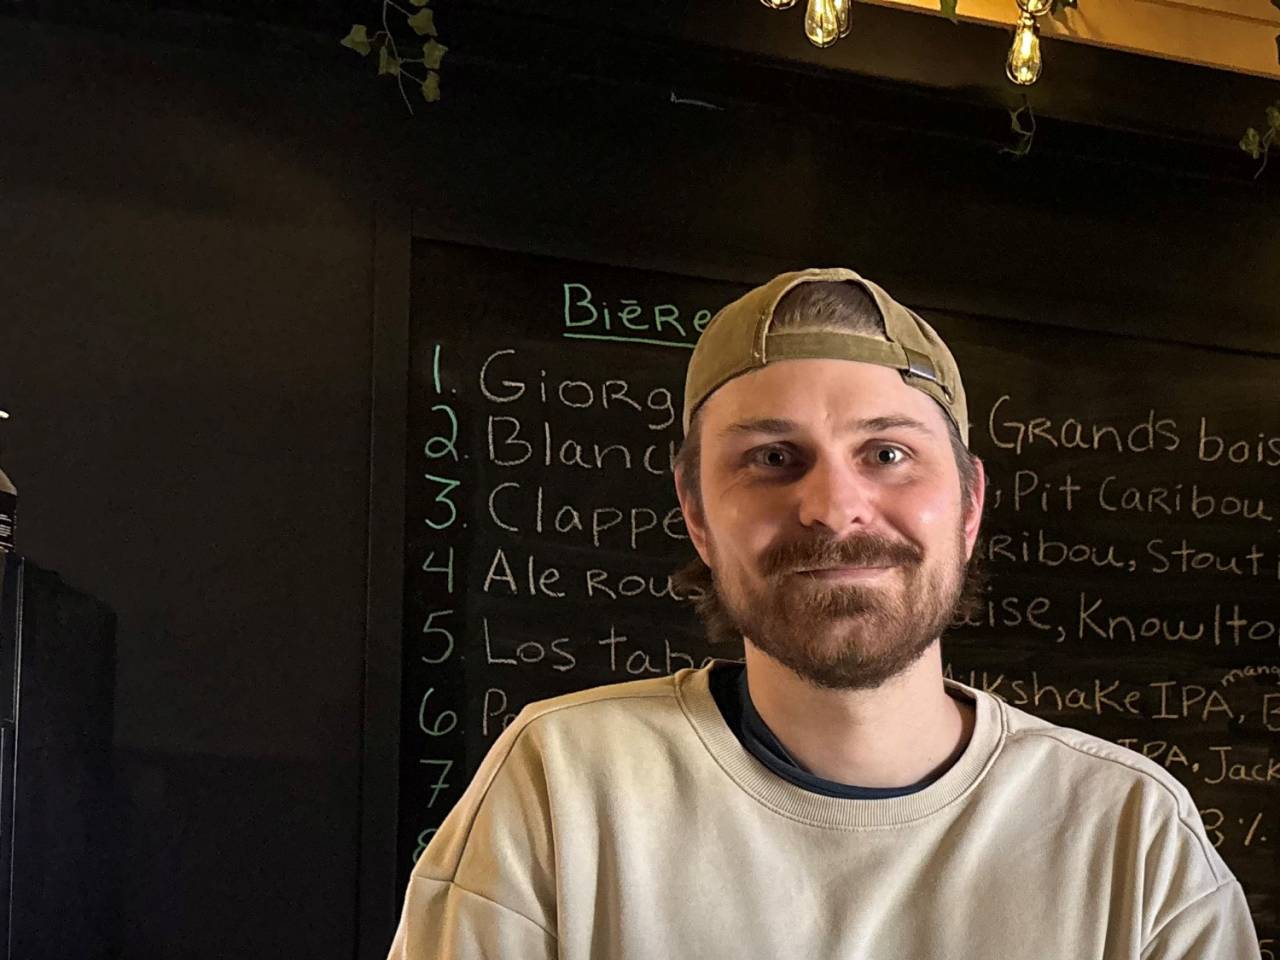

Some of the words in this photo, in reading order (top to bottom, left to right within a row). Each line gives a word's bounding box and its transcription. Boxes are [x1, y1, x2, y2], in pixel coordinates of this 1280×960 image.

[1014, 469, 1081, 512] Pit
[421, 547, 455, 593] 4
[483, 548, 567, 597] Ale
[1146, 539, 1264, 576] Stout
[483, 617, 577, 673] Los
[943, 662, 1142, 714] lkshake
[1150, 680, 1247, 724] IPA,
[418, 758, 455, 809] 7
